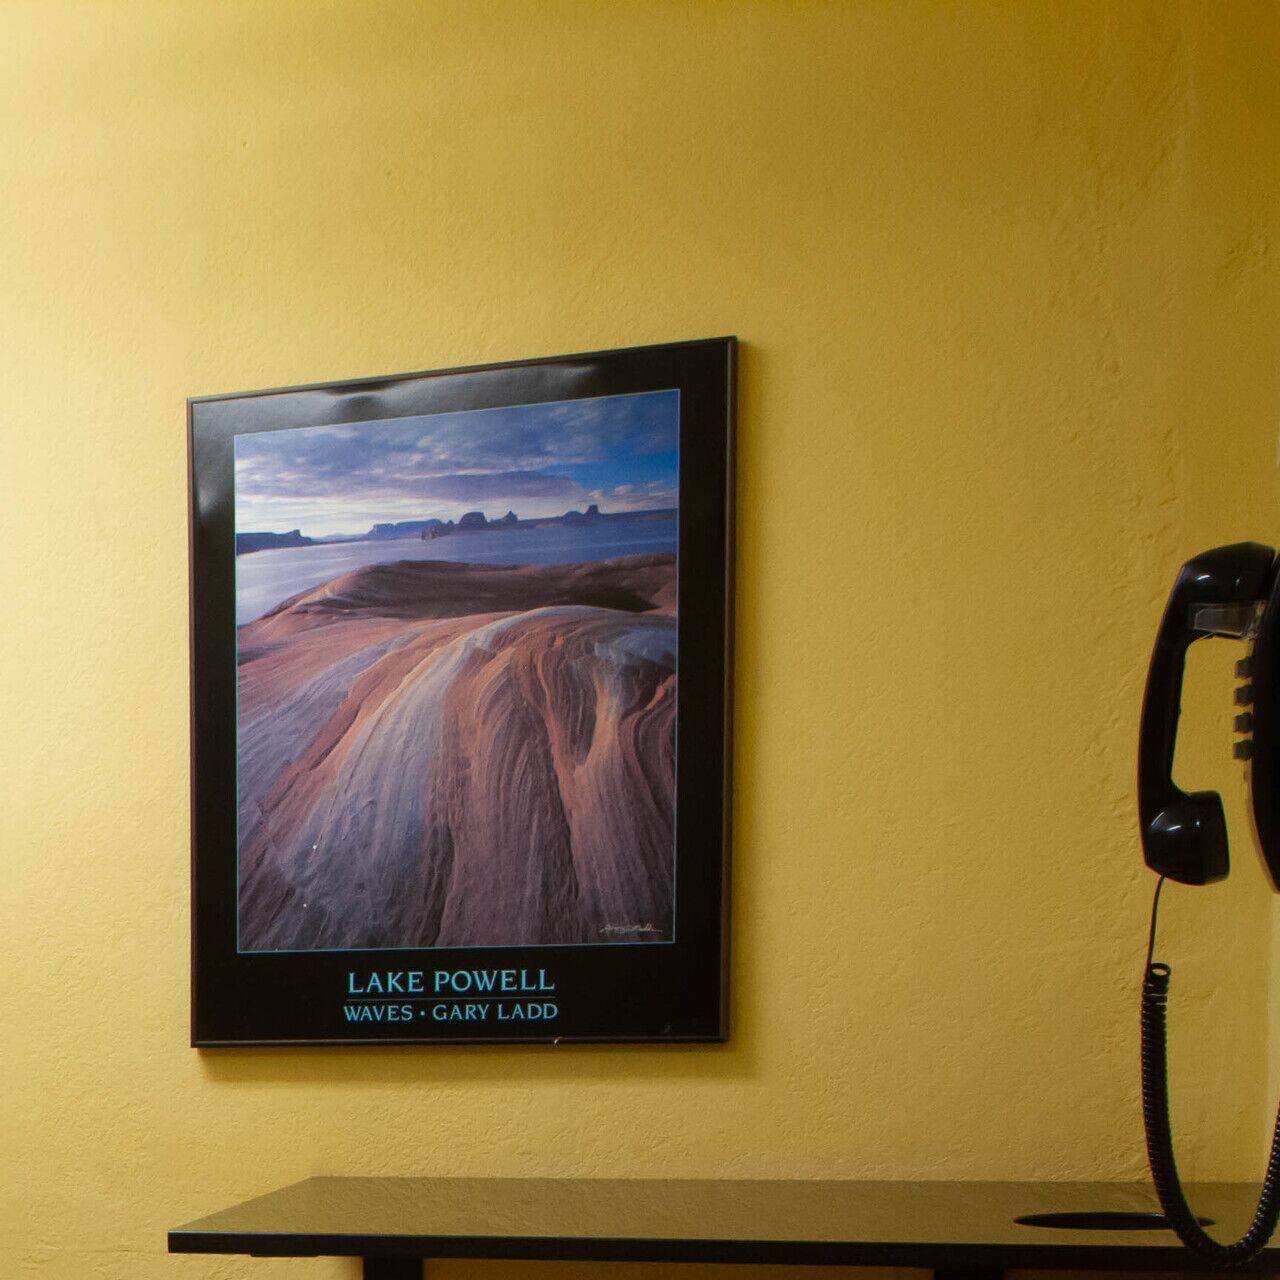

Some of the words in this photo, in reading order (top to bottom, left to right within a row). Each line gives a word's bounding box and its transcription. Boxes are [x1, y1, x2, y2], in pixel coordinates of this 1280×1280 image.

[348, 971, 424, 993] LAKE
[434, 969, 555, 992] POWELL
[343, 1004, 413, 1021] WAVES
[432, 1003, 490, 1021] GARY
[497, 1003, 558, 1020] LADD
